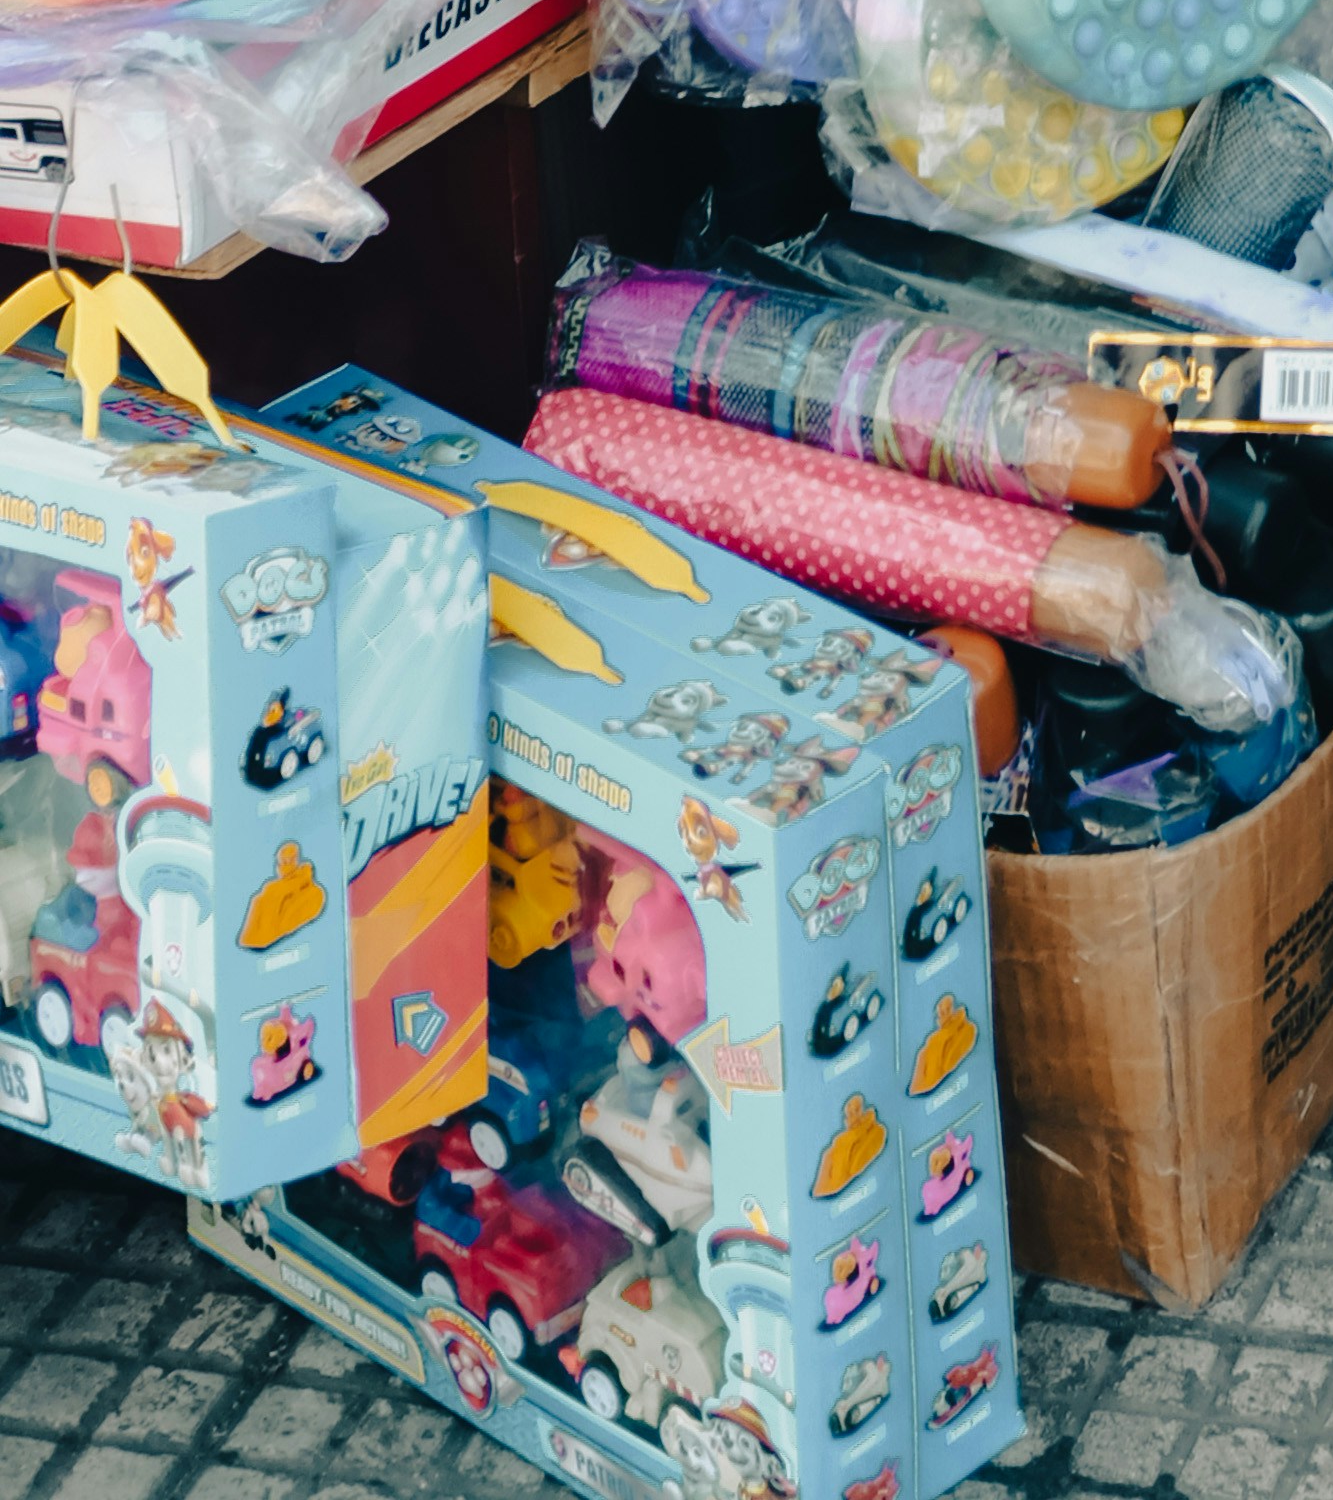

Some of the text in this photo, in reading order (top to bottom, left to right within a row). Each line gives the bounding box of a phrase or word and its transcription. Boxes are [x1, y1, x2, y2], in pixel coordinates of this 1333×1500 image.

[0, 492, 106, 548] inds of shape
[502, 719, 551, 773] Kinds
[554, 750, 574, 787] of
[576, 762, 633, 815] shape
[343, 755, 486, 874] DRIVE!
[280, 1265, 319, 1306] READY
[321, 1289, 349, 1320] FOR
[350, 1307, 408, 1358] ACTION
